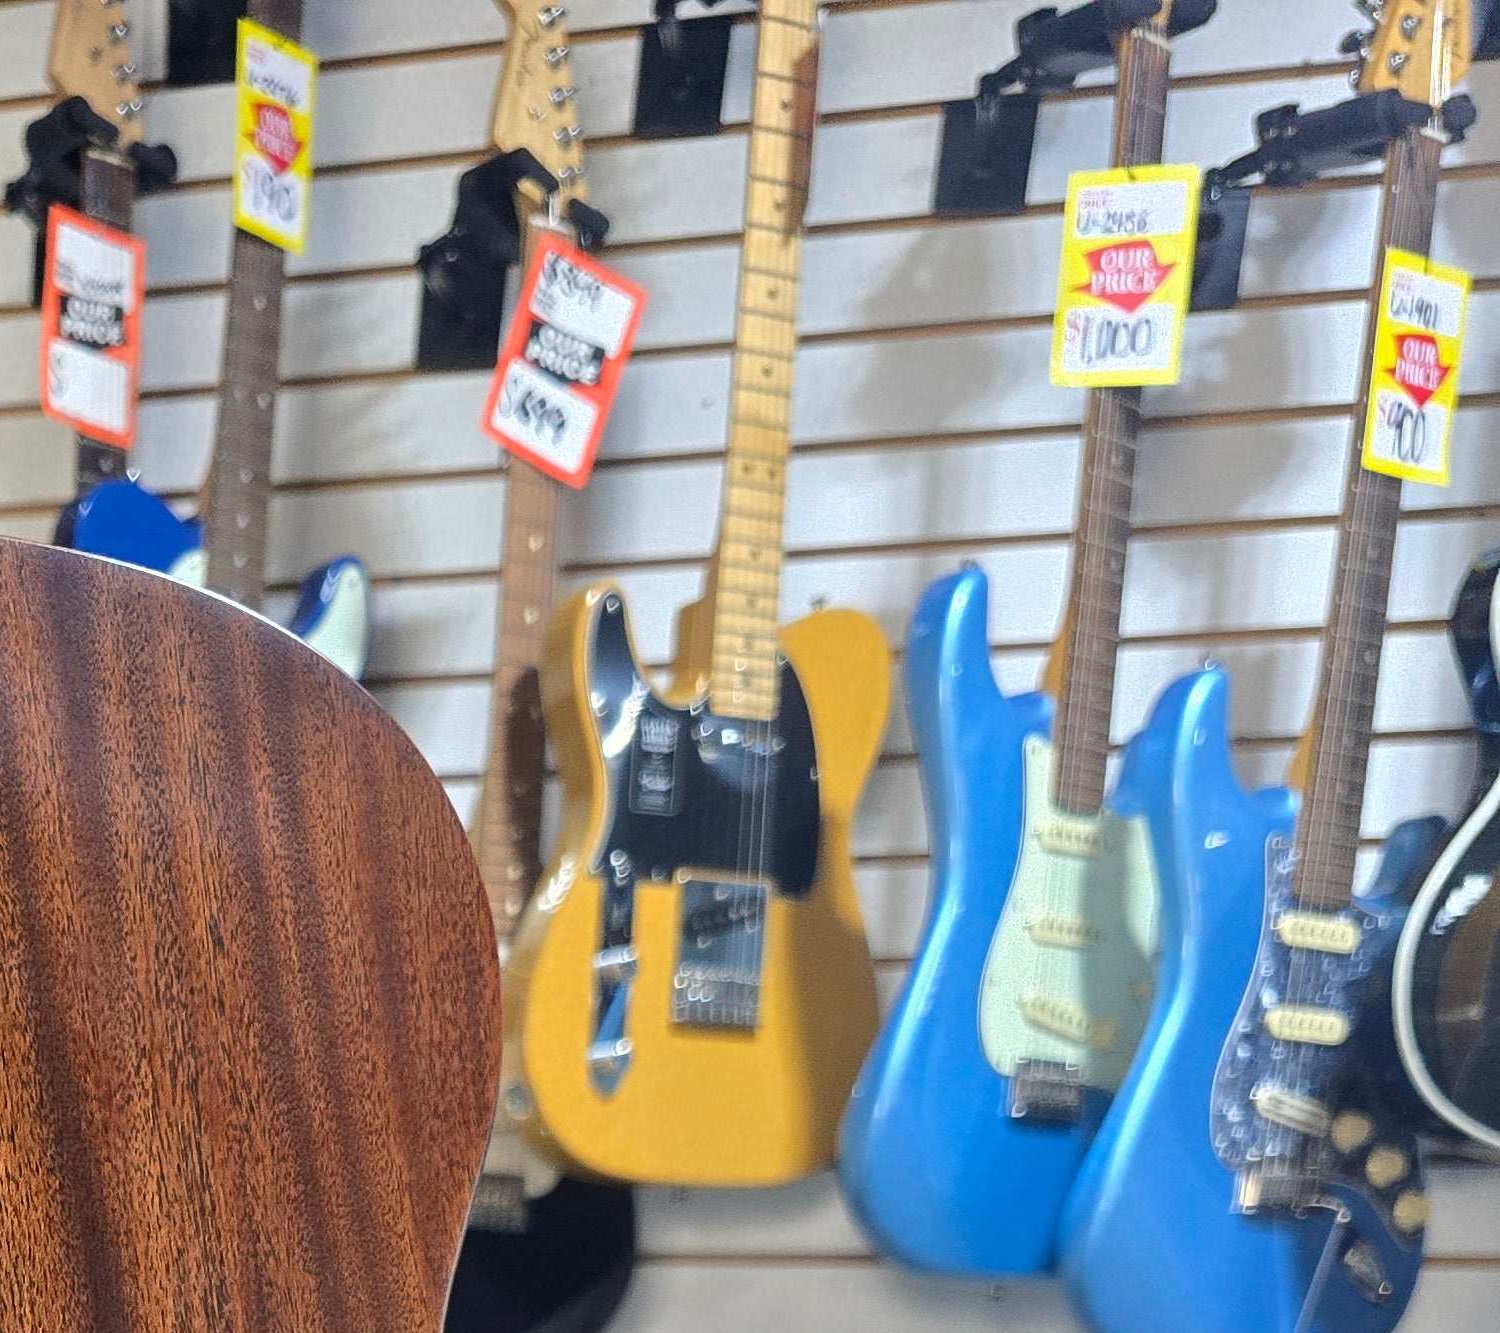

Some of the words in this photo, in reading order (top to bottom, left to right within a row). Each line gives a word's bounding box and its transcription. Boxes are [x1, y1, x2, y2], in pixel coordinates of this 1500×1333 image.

[1100, 248, 1155, 272] OUR
[1090, 270, 1158, 295] PRICE
[66, 297, 117, 323] OUR
[538, 322, 596, 359] OUR
[1402, 336, 1438, 367] OUR
[524, 336, 603, 387] PRICE
[1394, 361, 1444, 392] PRICE
